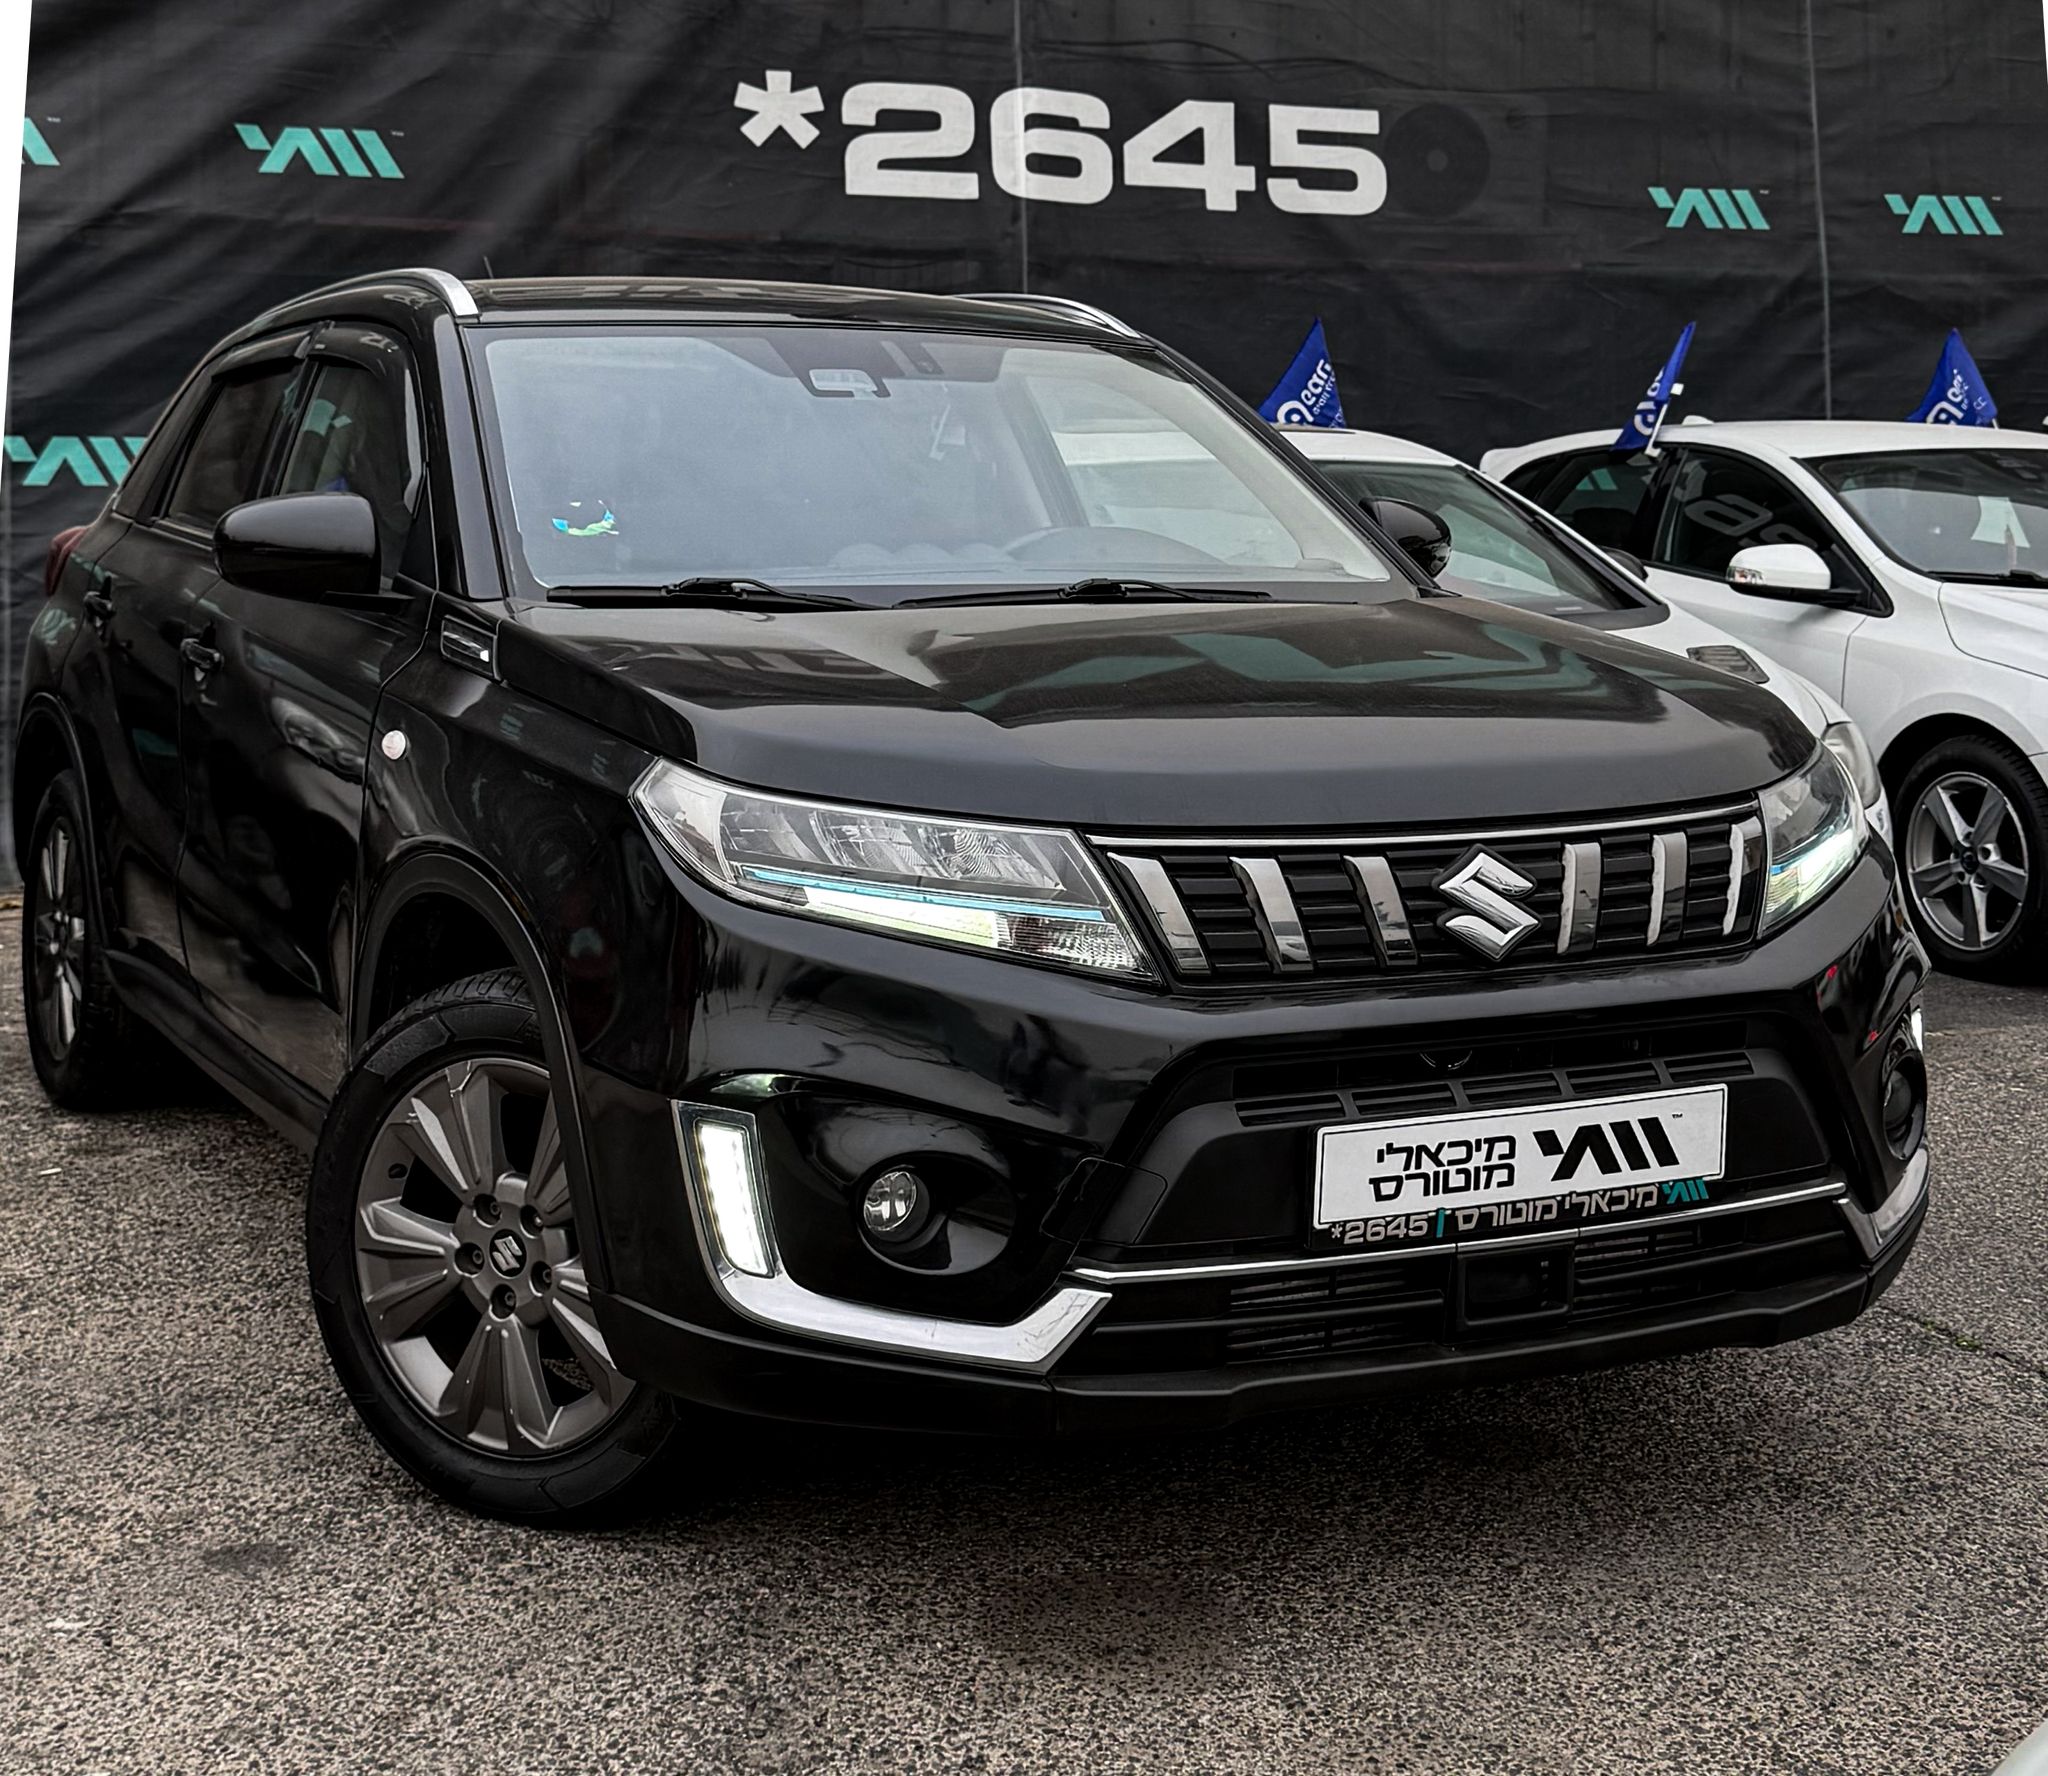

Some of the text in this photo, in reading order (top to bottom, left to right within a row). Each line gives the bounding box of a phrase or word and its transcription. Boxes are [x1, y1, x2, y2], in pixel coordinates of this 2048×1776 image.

[1377, 1135, 1516, 1172] מיכאלי
[1369, 1163, 1515, 1202] מוטורס
[1454, 1199, 1559, 1232] מוטורס
[1564, 1184, 1658, 1218] מיכאלי
